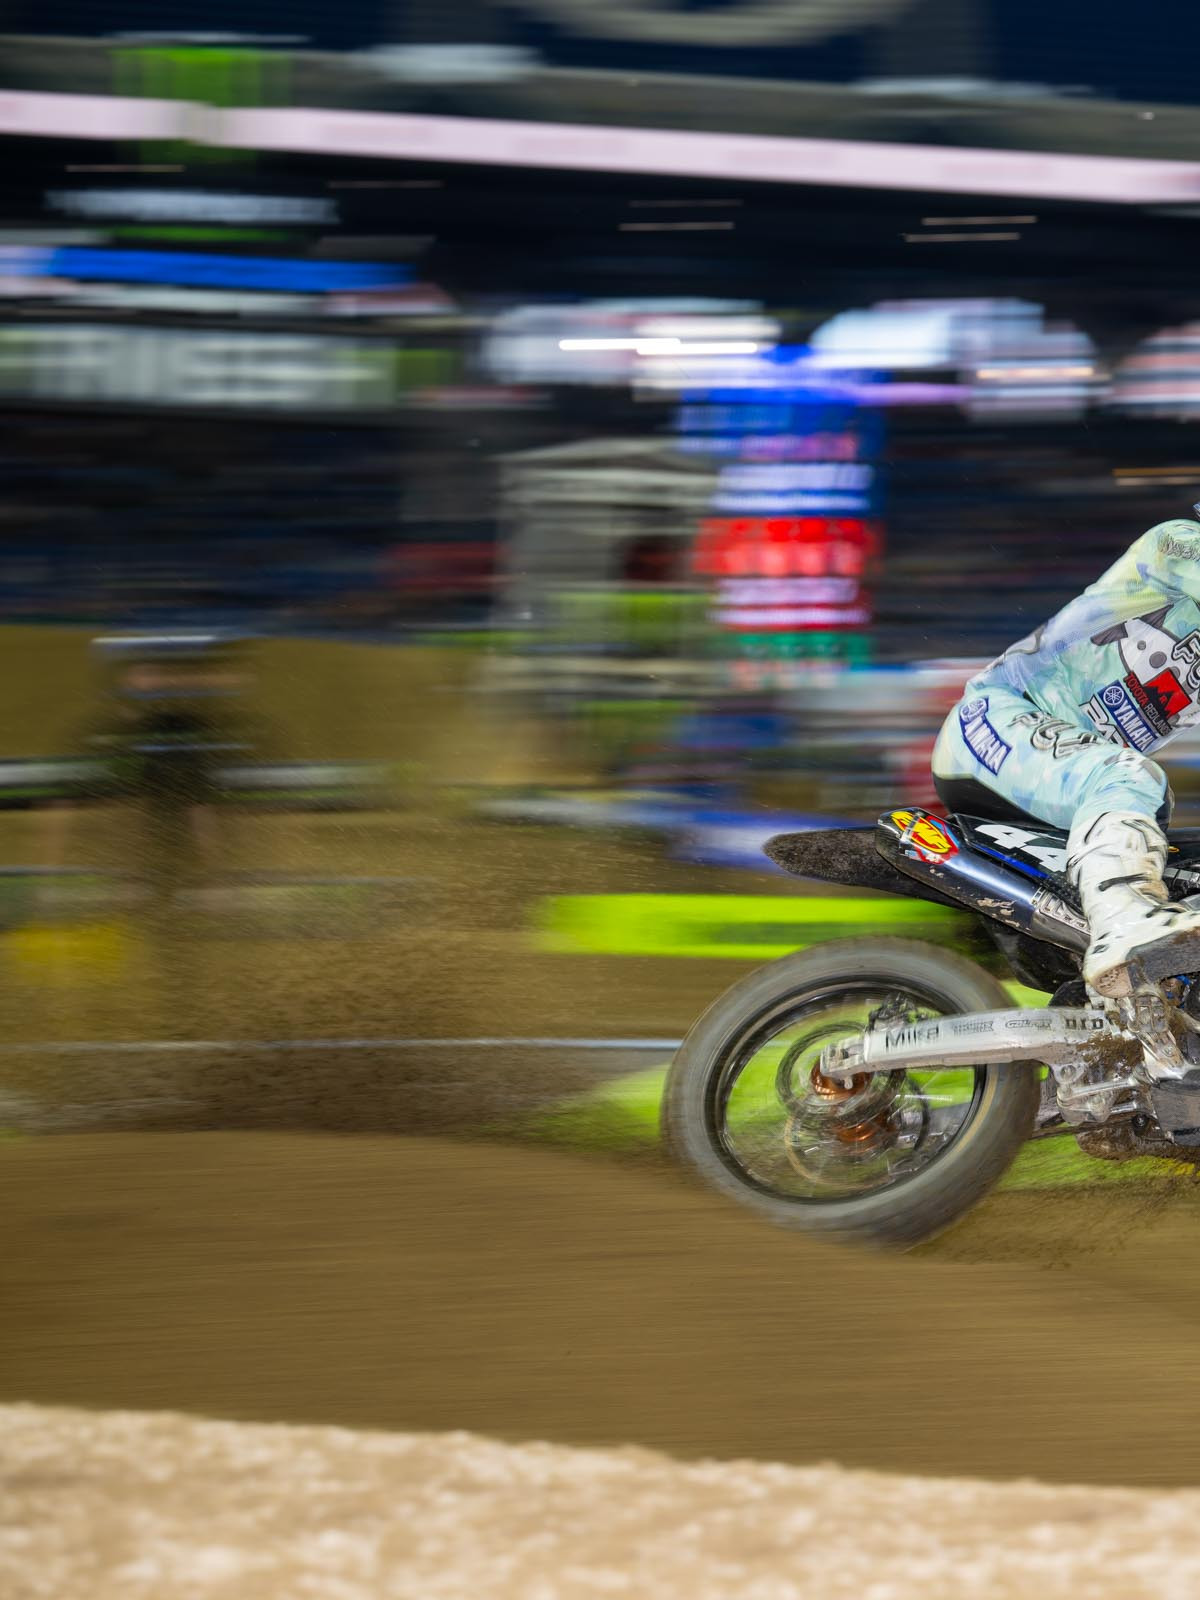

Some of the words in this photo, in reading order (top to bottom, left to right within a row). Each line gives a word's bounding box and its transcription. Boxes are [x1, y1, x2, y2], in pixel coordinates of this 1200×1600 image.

[1124, 672, 1148, 706] TOYOTA
[1143, 703, 1172, 736] REDLANDS
[974, 824, 1070, 873] 44
